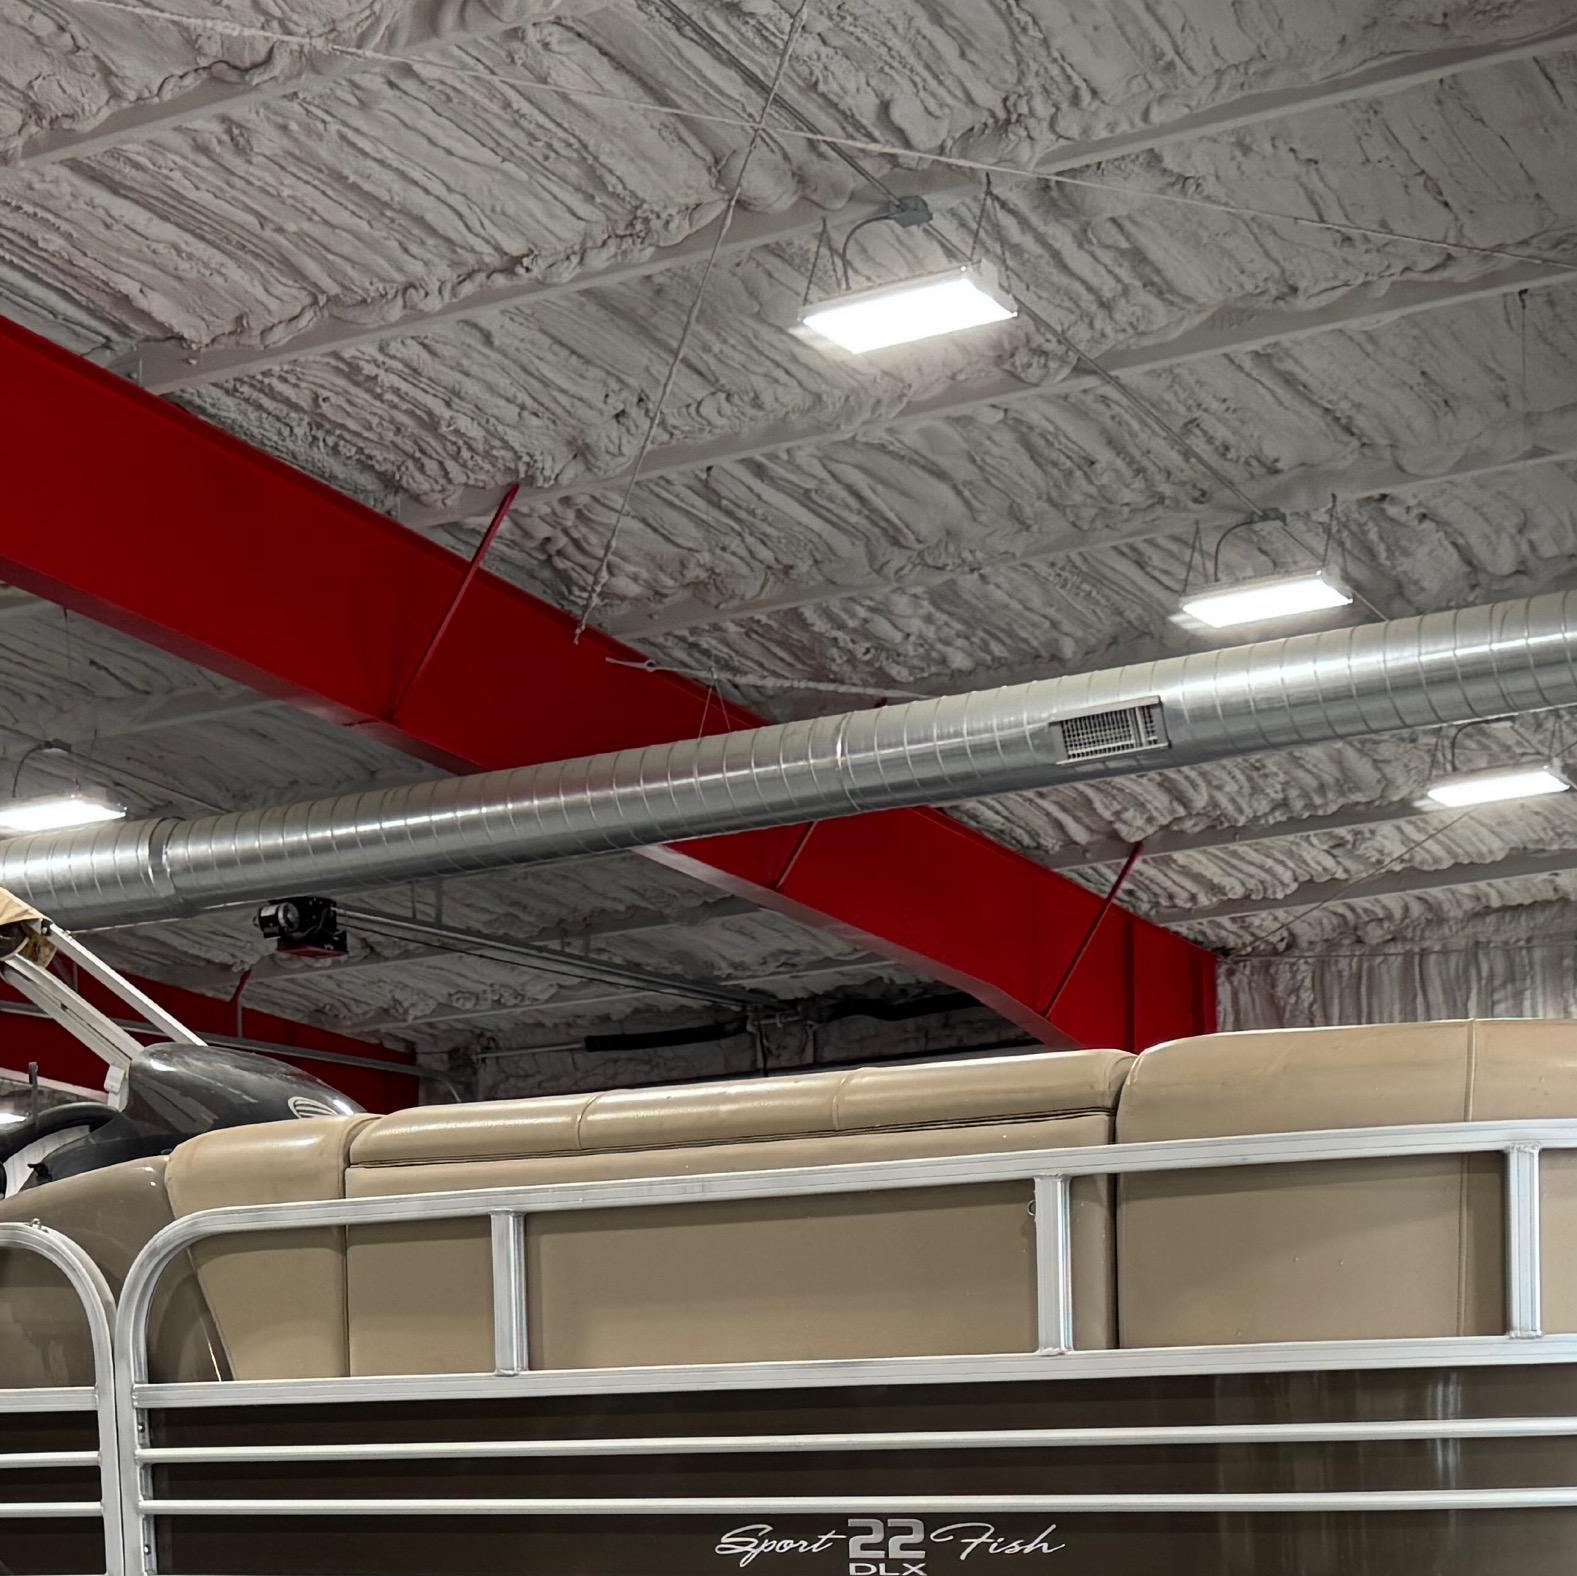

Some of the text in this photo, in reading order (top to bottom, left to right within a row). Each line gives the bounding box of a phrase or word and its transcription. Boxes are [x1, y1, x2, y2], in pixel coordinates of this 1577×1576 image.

[715, 1518, 1066, 1567] Sport 22 Fish
[849, 1562, 928, 1576] DLX
